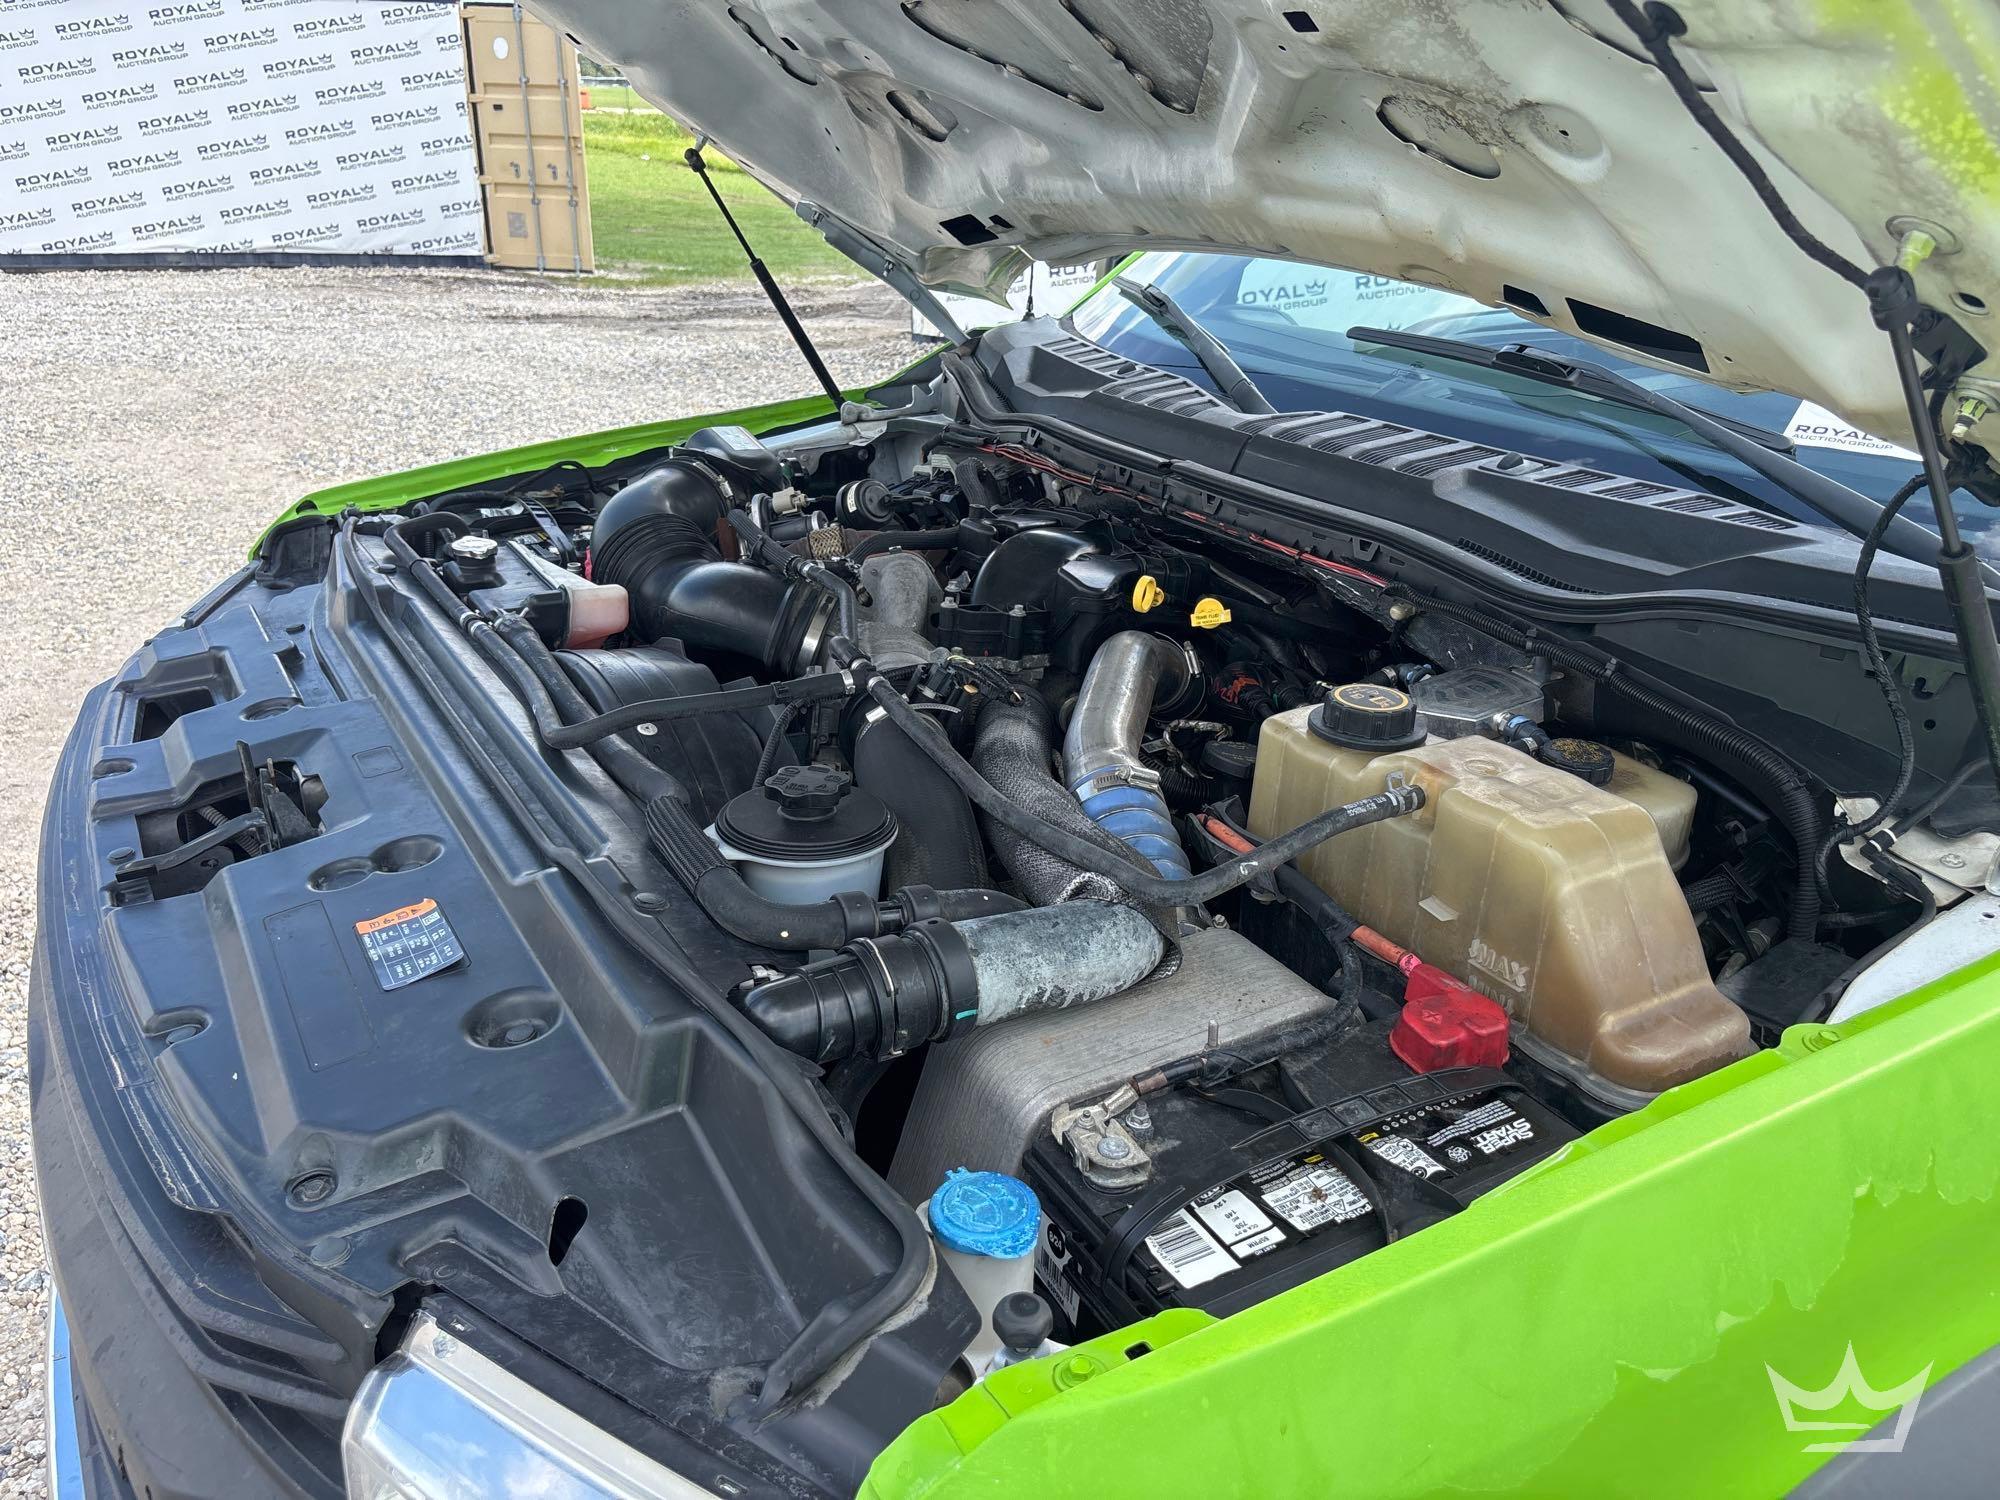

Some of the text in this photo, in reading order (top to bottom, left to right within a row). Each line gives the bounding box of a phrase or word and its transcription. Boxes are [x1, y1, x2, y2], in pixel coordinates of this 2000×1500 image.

[0, 3, 36, 12] UCTION
[148, 3, 207, 19] ROYAL
[381, 3, 436, 19] ROYAL
[55, 17, 115, 34] ROYAL
[153, 11, 225, 26] AUCTION GROUP
[293, 17, 349, 33] ROYAL
[384, 16, 421, 26] AUCTION
[60, 25, 133, 41] AUCTION GROUP
[204, 31, 261, 47] ROYAL
[297, 24, 366, 40] AUCTION GROUP
[6, 40, 39, 50] GROUP
[208, 38, 278, 54] AUCTION GROUP
[350, 43, 405, 59] ROYAL
[112, 46, 171, 62] ROYAL
[117, 53, 189, 69] AUCTION GROUP
[18, 60, 78, 77] ROYAL
[263, 57, 319, 73] ROYAL
[267, 64, 336, 80] AUCTION GROUP
[23, 68, 97, 84] AUCTION GROUP
[173, 72, 230, 88] ROYAL
[401, 70, 455, 86] ROYAL
[82, 87, 140, 103] ROYAL
[178, 79, 248, 95] AUCTION GROUP
[315, 84, 370, 99] ROYAL
[87, 94, 159, 110] AUCTION GROUP
[227, 98, 283, 114] ROYAL
[319, 91, 386, 106] AUCTION GROUP
[0, 102, 48, 117] OYAL
[34, 109, 66, 120] GROUP
[231, 105, 300, 121] AUCTION GROUP
[371, 109, 425, 125] ROYAL
[138, 113, 194, 130] ROYAL
[142, 120, 212, 137] AUCTION GROUP
[45, 129, 104, 146] ROYAL
[285, 123, 340, 139] ROYAL
[289, 130, 357, 146] AUCTION GROUP
[50, 136, 123, 153] AUCTION GROUP
[197, 138, 253, 155] ROYAL
[421, 135, 472, 151] ROYAL
[201, 145, 270, 161] AUCTION GROUP
[336, 149, 390, 165] ROYAL
[107, 154, 165, 171] ROYAL
[112, 160, 182, 177] AUCTION GROUP
[15, 170, 74, 187] ROYAL
[249, 164, 305, 180] ROYAL
[254, 170, 322, 186] AUCTION GROUP
[20, 176, 92, 194] AUCTION GROUP
[162, 179, 218, 196] ROYAL
[391, 173, 444, 189] ROYAL
[166, 185, 235, 202] AUCTION GROUP
[307, 188, 361, 204] ROYAL
[71, 195, 129, 212] ROYAL
[76, 201, 147, 219] AUCTION GROUP
[311, 194, 377, 210] AUCTION GROUP
[440, 199, 481, 214] ROYA
[220, 203, 275, 219] ROYAL
[224, 209, 292, 225] AUCTION GROUP
[25, 217, 56, 228] GROUP
[132, 218, 188, 235] ROYAL
[357, 212, 410, 228] ROYAL
[136, 224, 205, 242] AUCTION GROUP
[272, 227, 326, 243] ROYAL
[41, 234, 101, 252] ROYAL
[411, 235, 463, 250] ROYAL
[1242, 284, 1305, 305] OYAL
[1357, 286, 1416, 302] AUCTION
[1284, 297, 1329, 313] GROUP
[1795, 424, 1874, 441] ROYAL
[1792, 433, 1894, 450] AUCTION GROUP
[1476, 1118, 1532, 1148] START
[1480, 1131, 1534, 1154] SUPER
